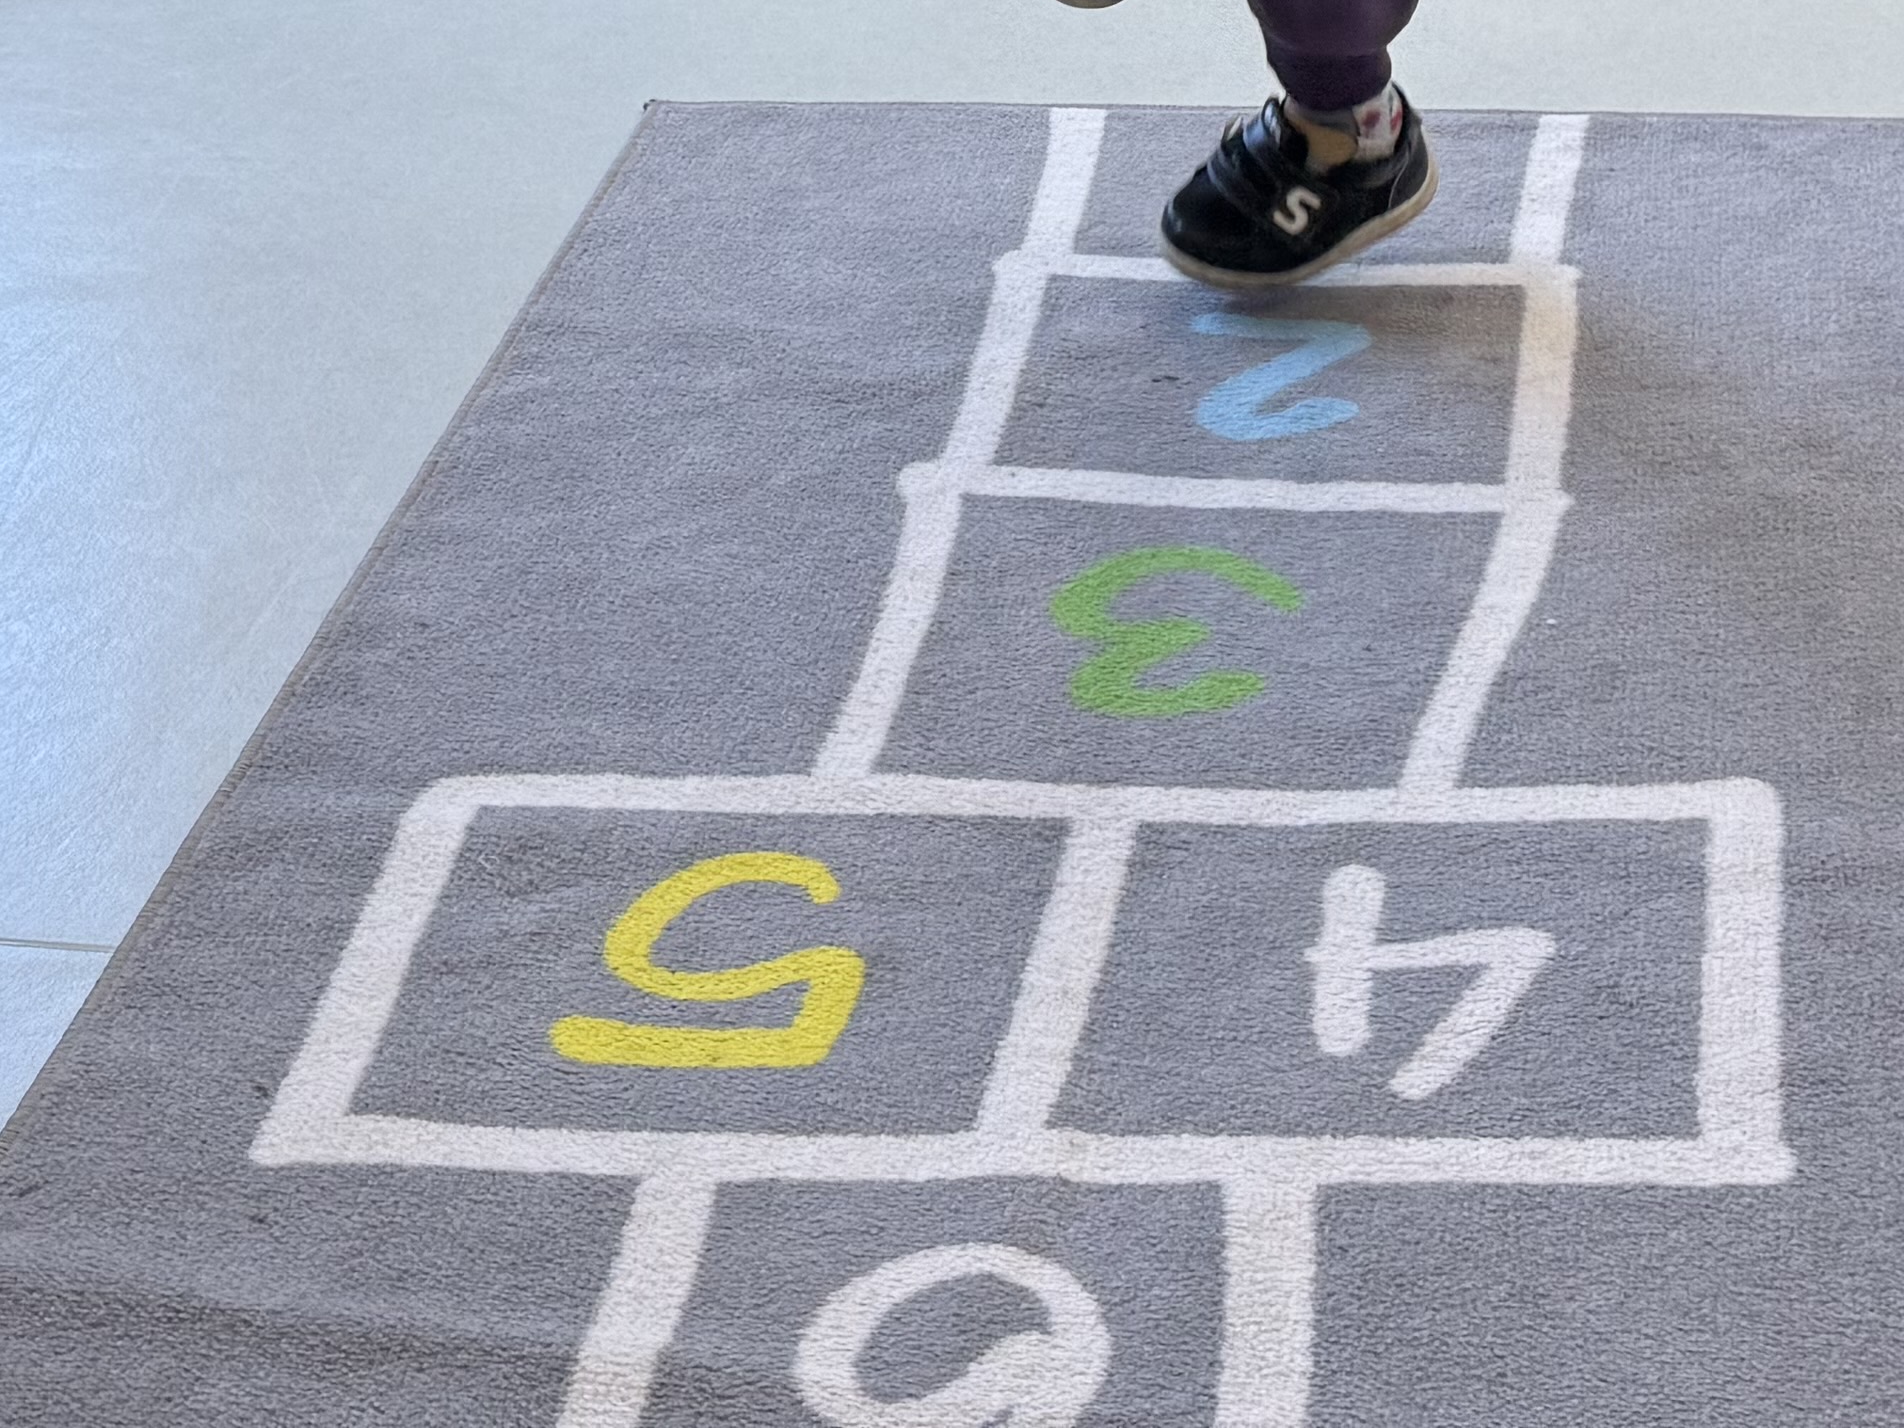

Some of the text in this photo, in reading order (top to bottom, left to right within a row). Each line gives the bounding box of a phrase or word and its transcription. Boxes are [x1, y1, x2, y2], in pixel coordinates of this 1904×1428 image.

[1273, 186, 1322, 236] S
[1191, 312, 1372, 441] 2
[1047, 544, 1306, 717] 3
[549, 850, 866, 1068] 5
[1307, 864, 1556, 1101] 4
